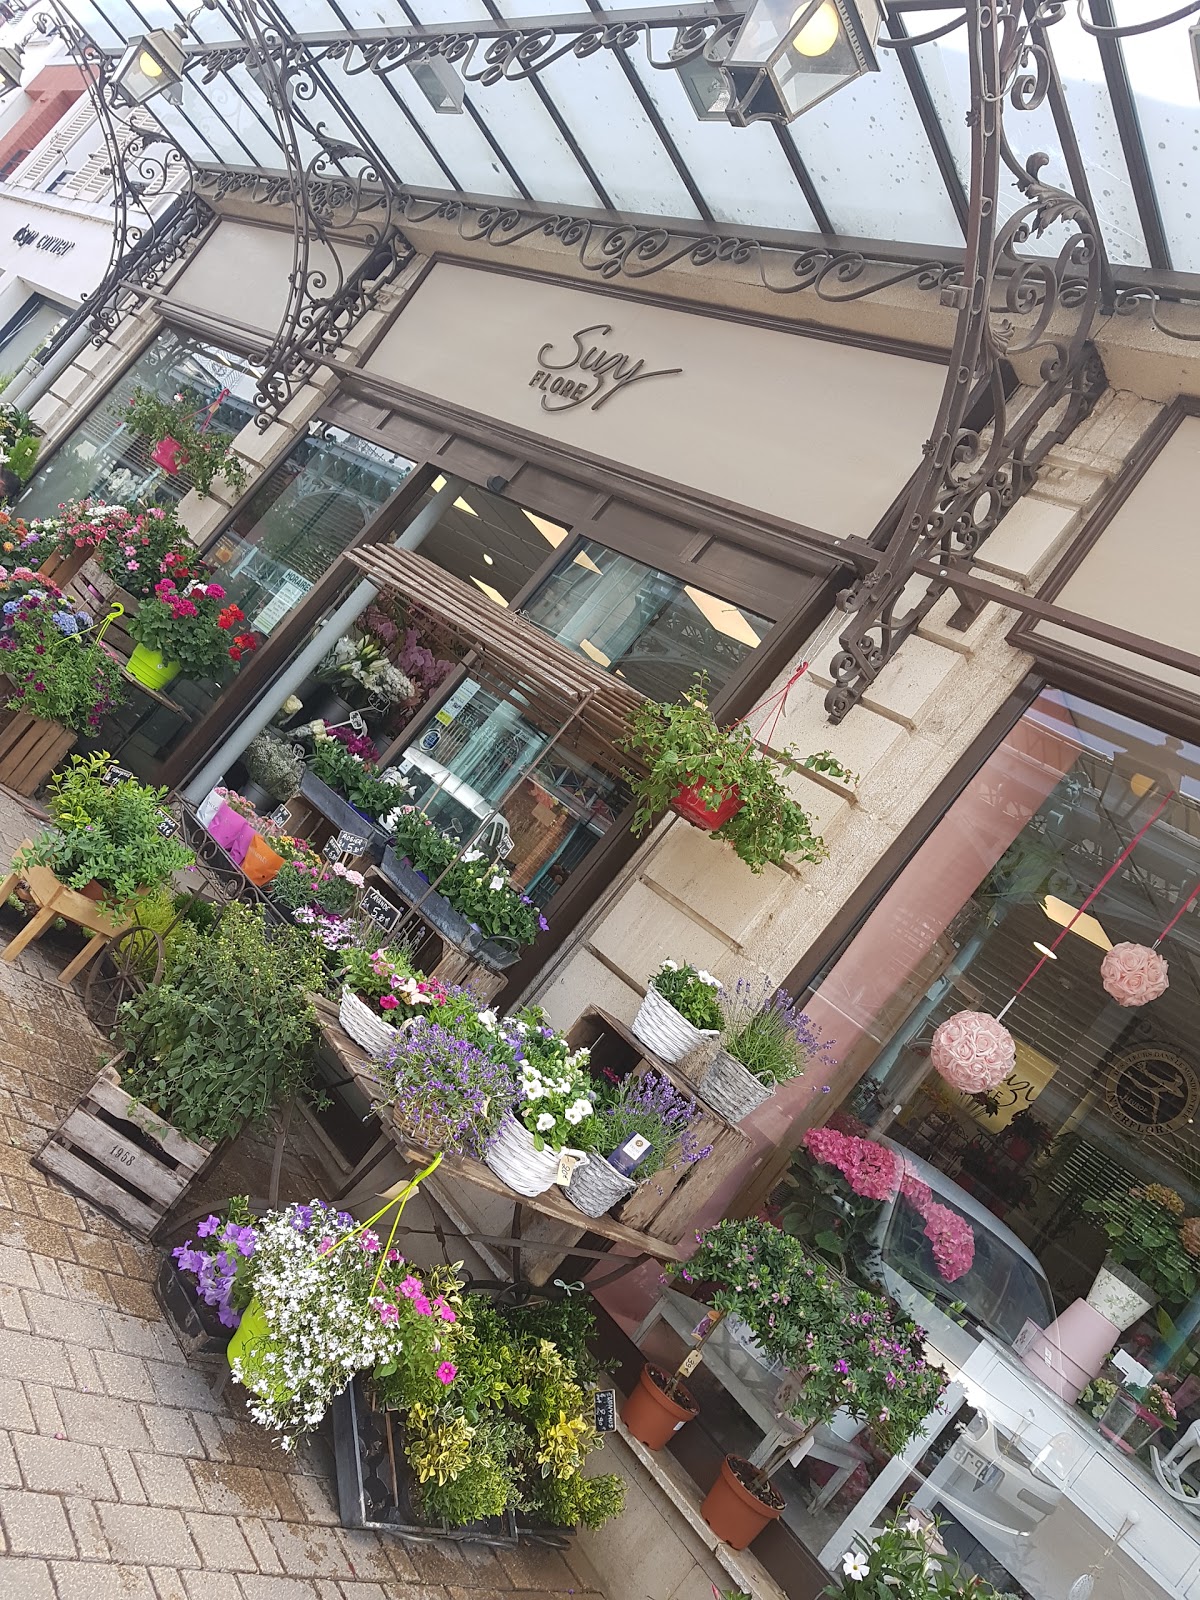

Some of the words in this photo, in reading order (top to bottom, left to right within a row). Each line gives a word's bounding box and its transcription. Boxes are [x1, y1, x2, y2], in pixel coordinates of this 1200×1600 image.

[36, 234, 76, 256] corner
[537, 324, 683, 412] Suzy
[528, 369, 588, 401] FLORE
[342, 832, 363, 846] ROSIER
[370, 892, 391, 912] LAVANDE
[1107, 1089, 1174, 1134] INTERFLORA
